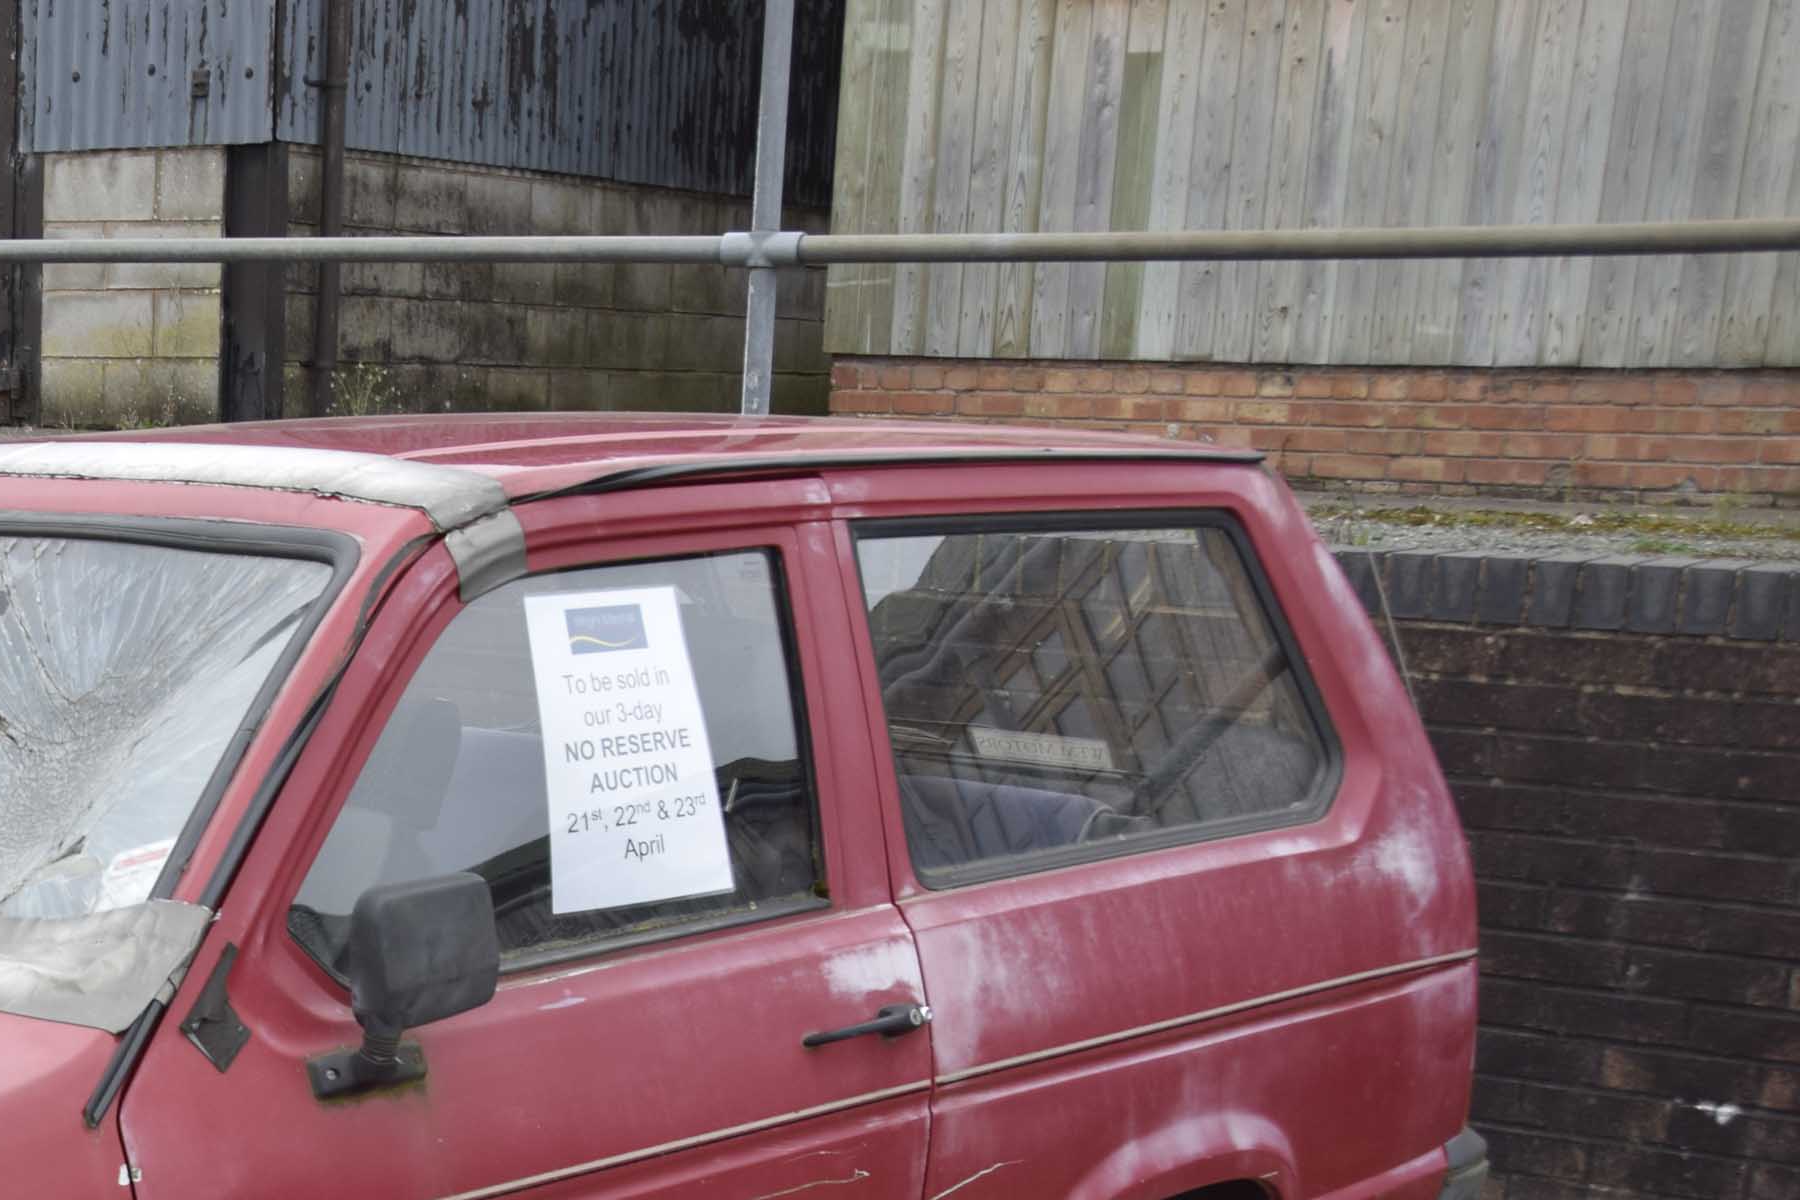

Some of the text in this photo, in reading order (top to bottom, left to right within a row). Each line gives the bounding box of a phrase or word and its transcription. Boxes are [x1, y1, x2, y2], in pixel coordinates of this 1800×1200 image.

[561, 666, 670, 696] To be sold in
[583, 701, 663, 728] our 3-day
[564, 727, 692, 763] NO RESERVE
[589, 762, 679, 794] AUCTION
[614, 801, 652, 826] 22nd
[656, 799, 670, 821] &
[674, 793, 707, 818] 23rd
[623, 833, 666, 863] April
